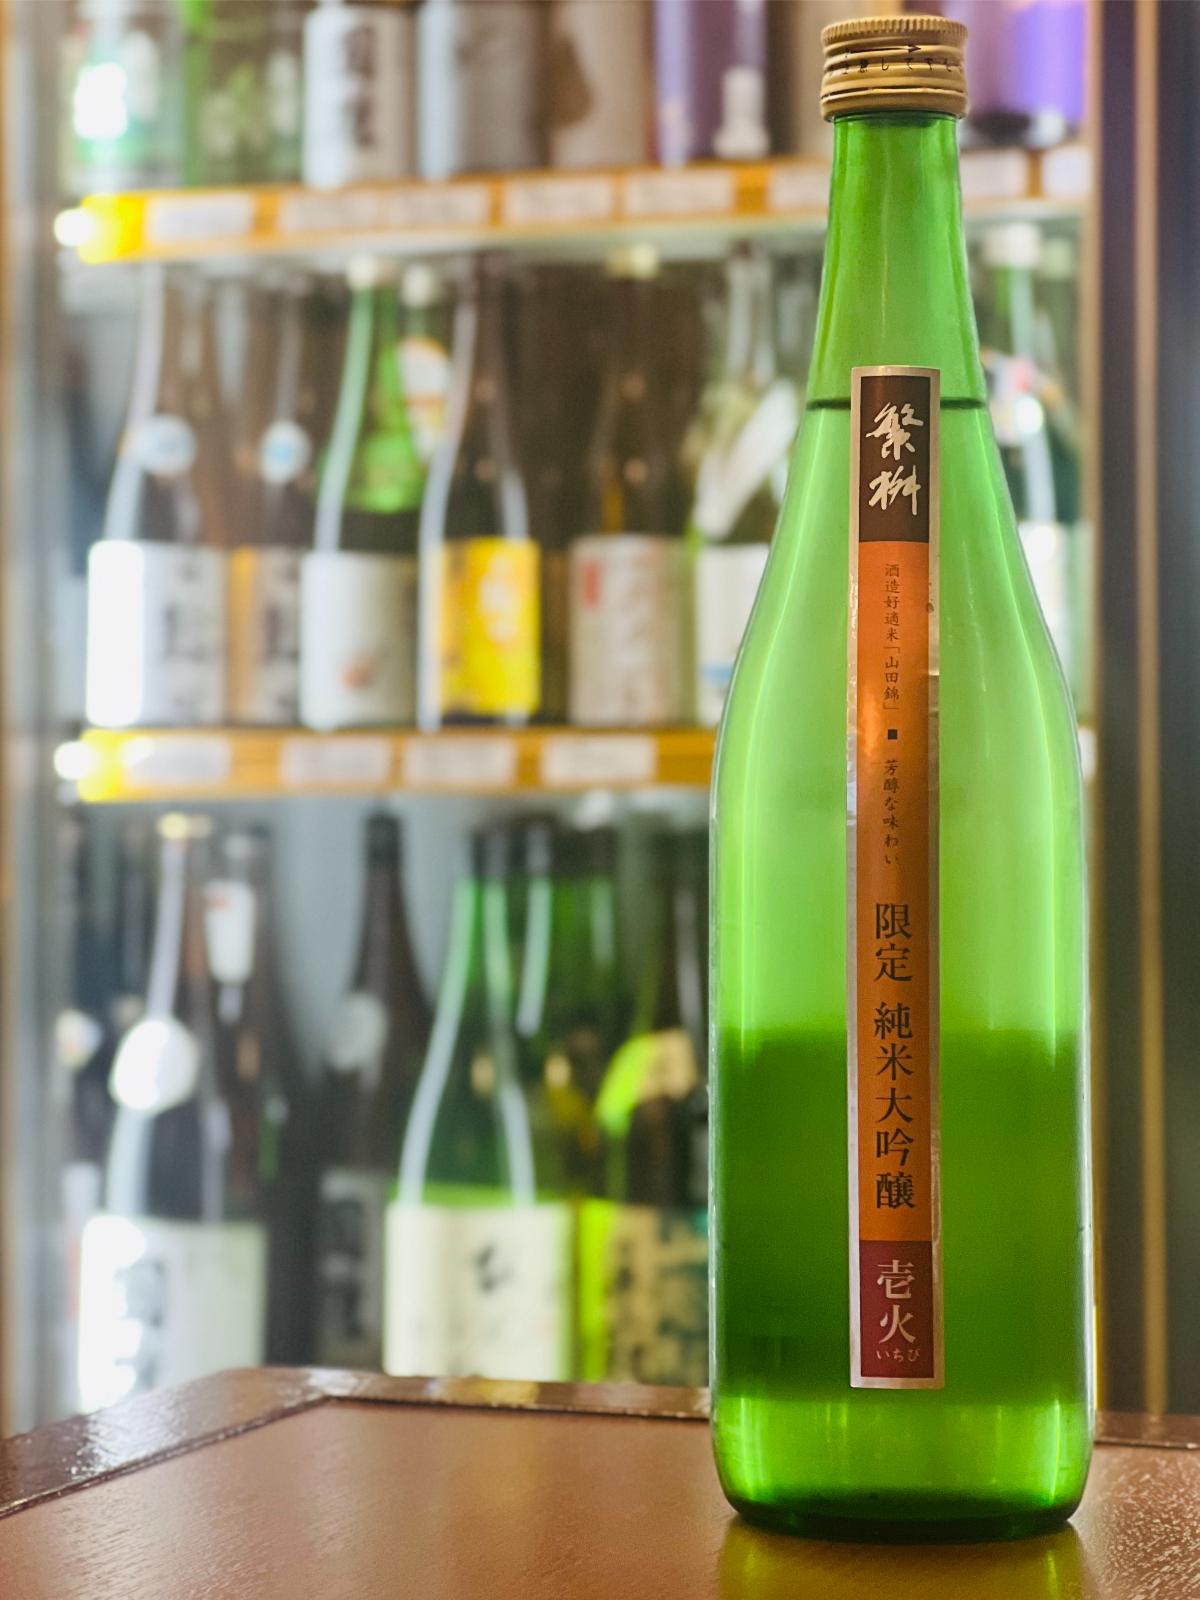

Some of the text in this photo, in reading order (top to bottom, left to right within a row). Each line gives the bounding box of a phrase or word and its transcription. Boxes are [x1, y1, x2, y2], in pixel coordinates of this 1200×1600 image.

[882, 759, 900, 865] 芳醇な味わい
[873, 902, 917, 1210] 限定 純米大吟醸
[876, 1259, 916, 1345] 壱火
[876, 1348, 921, 1363] いちび
